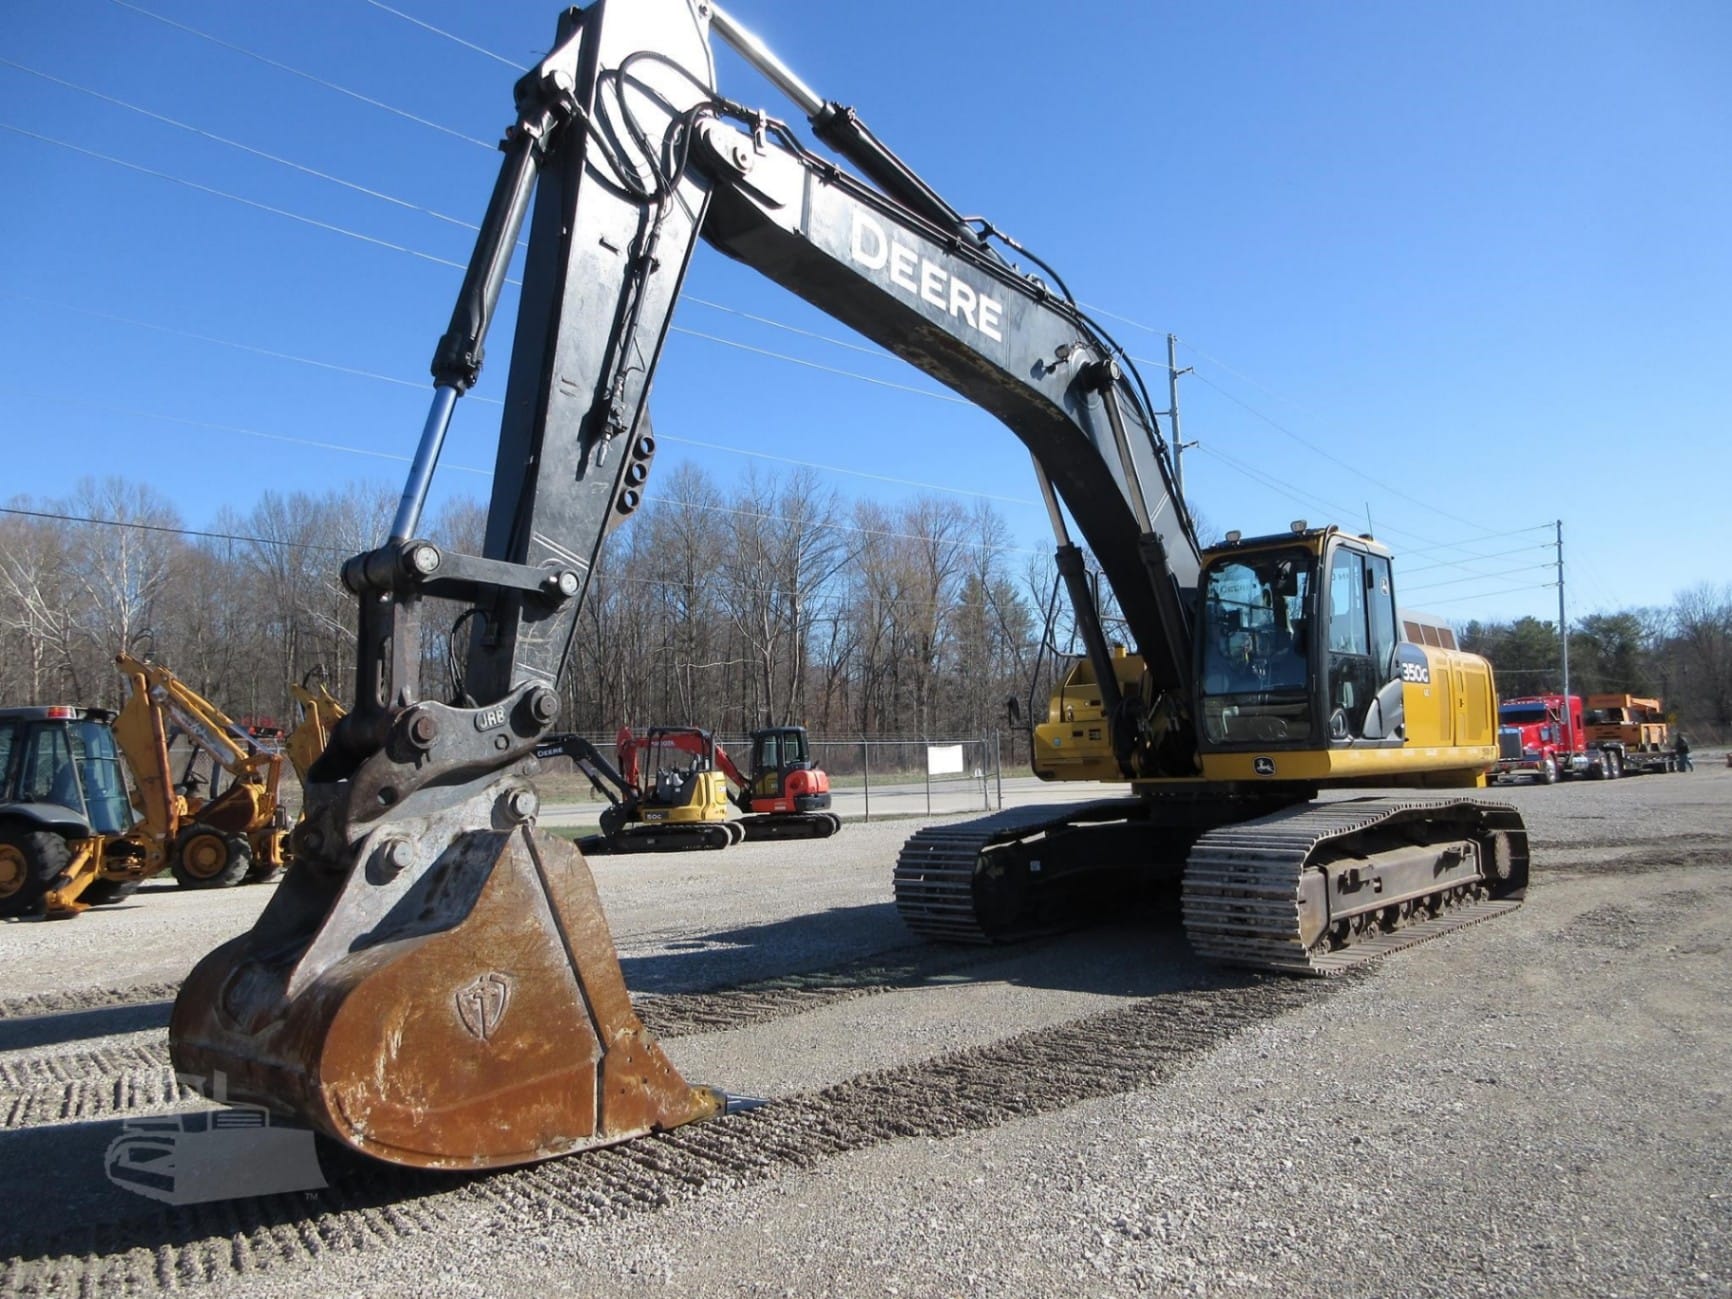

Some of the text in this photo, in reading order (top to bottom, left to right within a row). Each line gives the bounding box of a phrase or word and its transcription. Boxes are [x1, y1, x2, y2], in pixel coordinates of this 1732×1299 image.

[852, 206, 1002, 343] DEERE
[480, 708, 505, 729] JRB
[537, 746, 563, 757] DEERE
